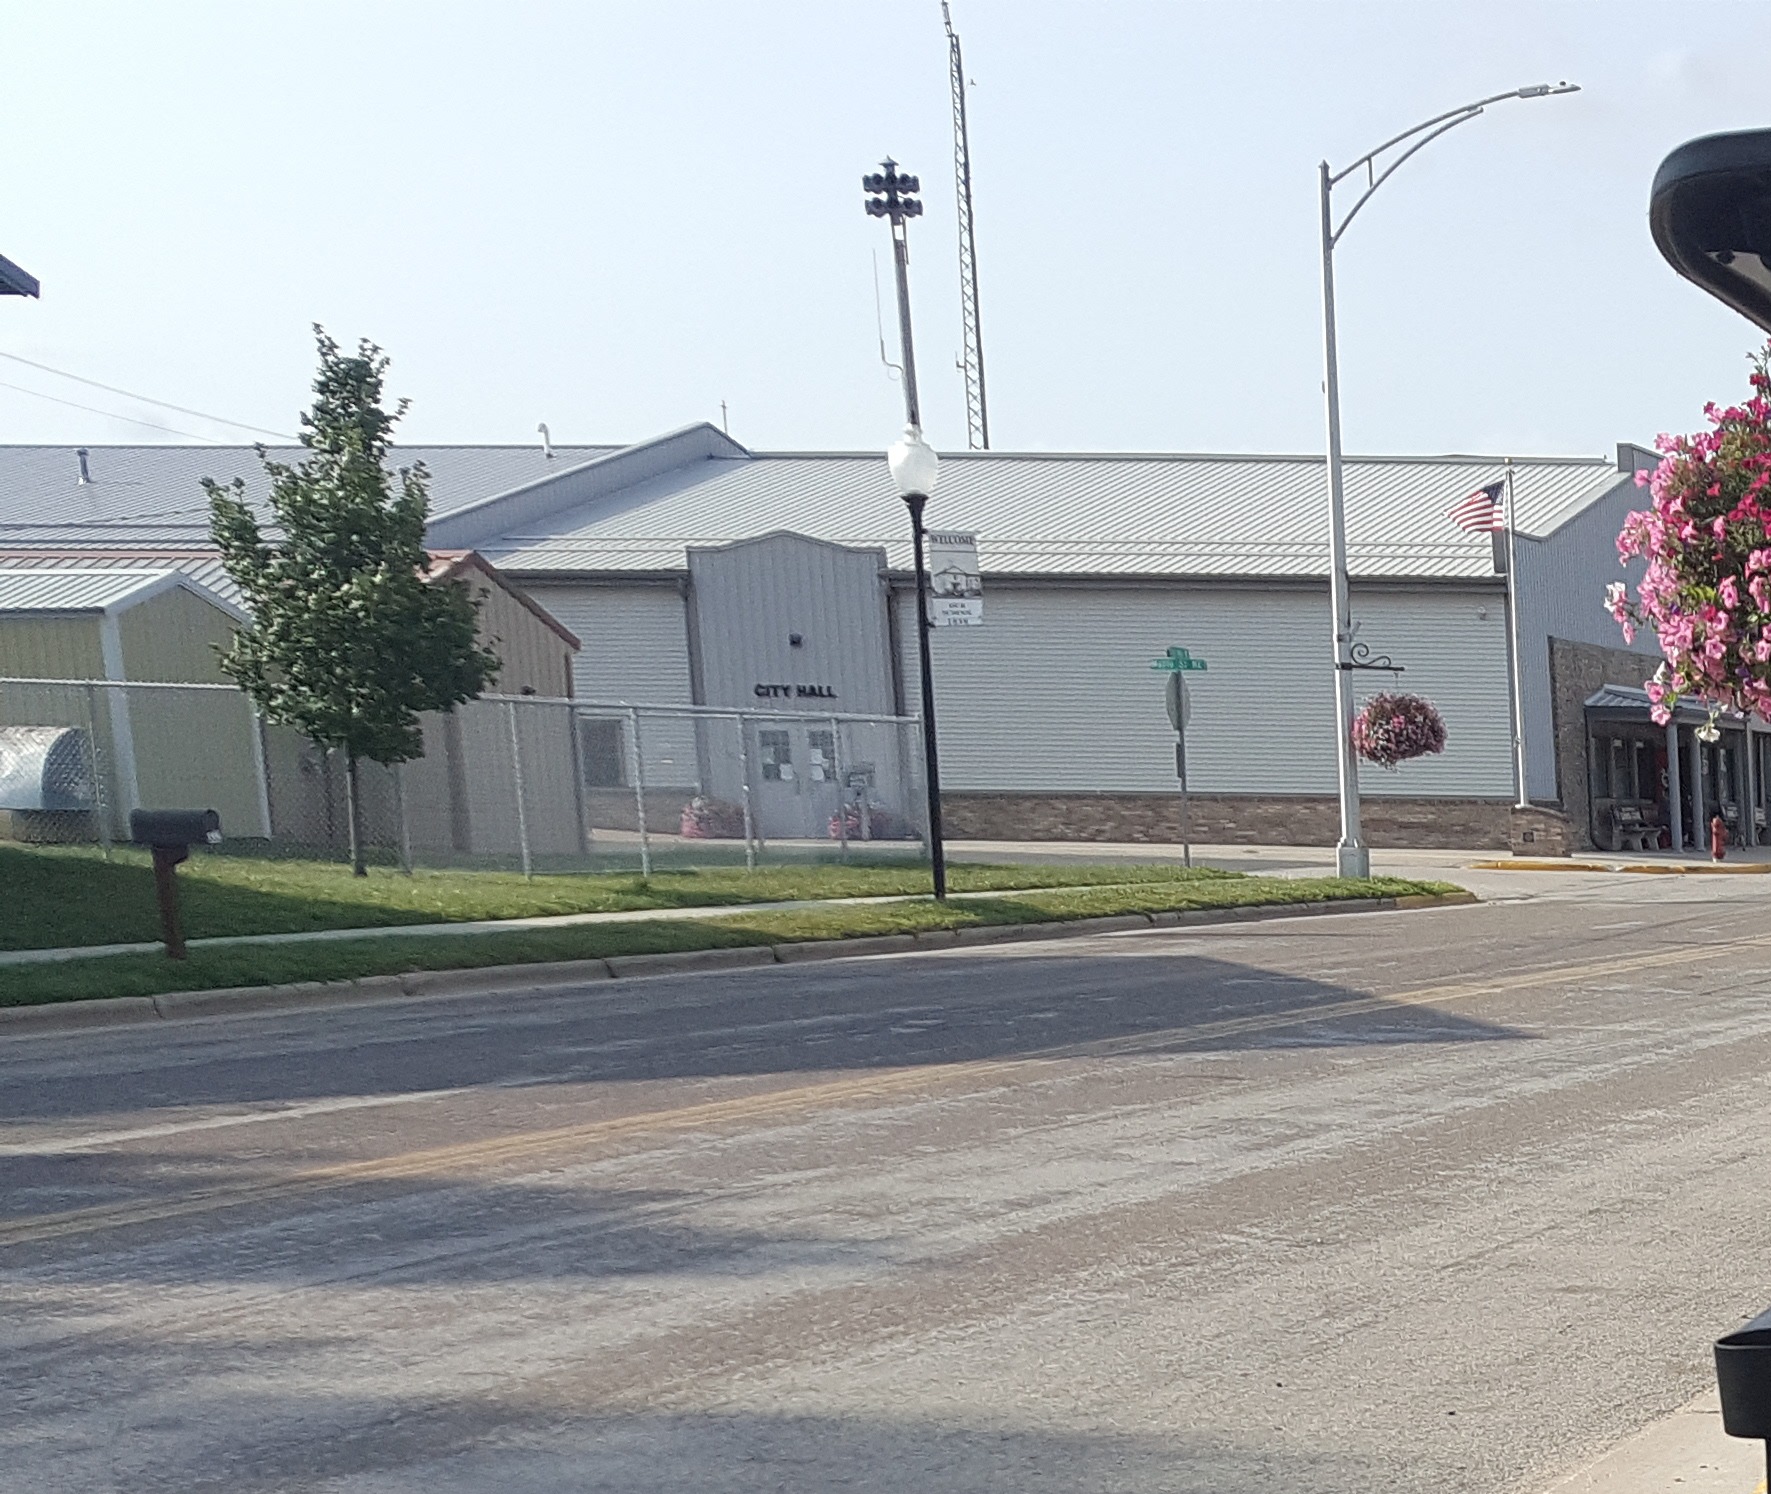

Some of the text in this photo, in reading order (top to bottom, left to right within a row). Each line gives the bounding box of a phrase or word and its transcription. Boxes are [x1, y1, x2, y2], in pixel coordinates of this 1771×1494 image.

[930, 534, 975, 546] WELCOME
[754, 683, 839, 699] CITY HALL
